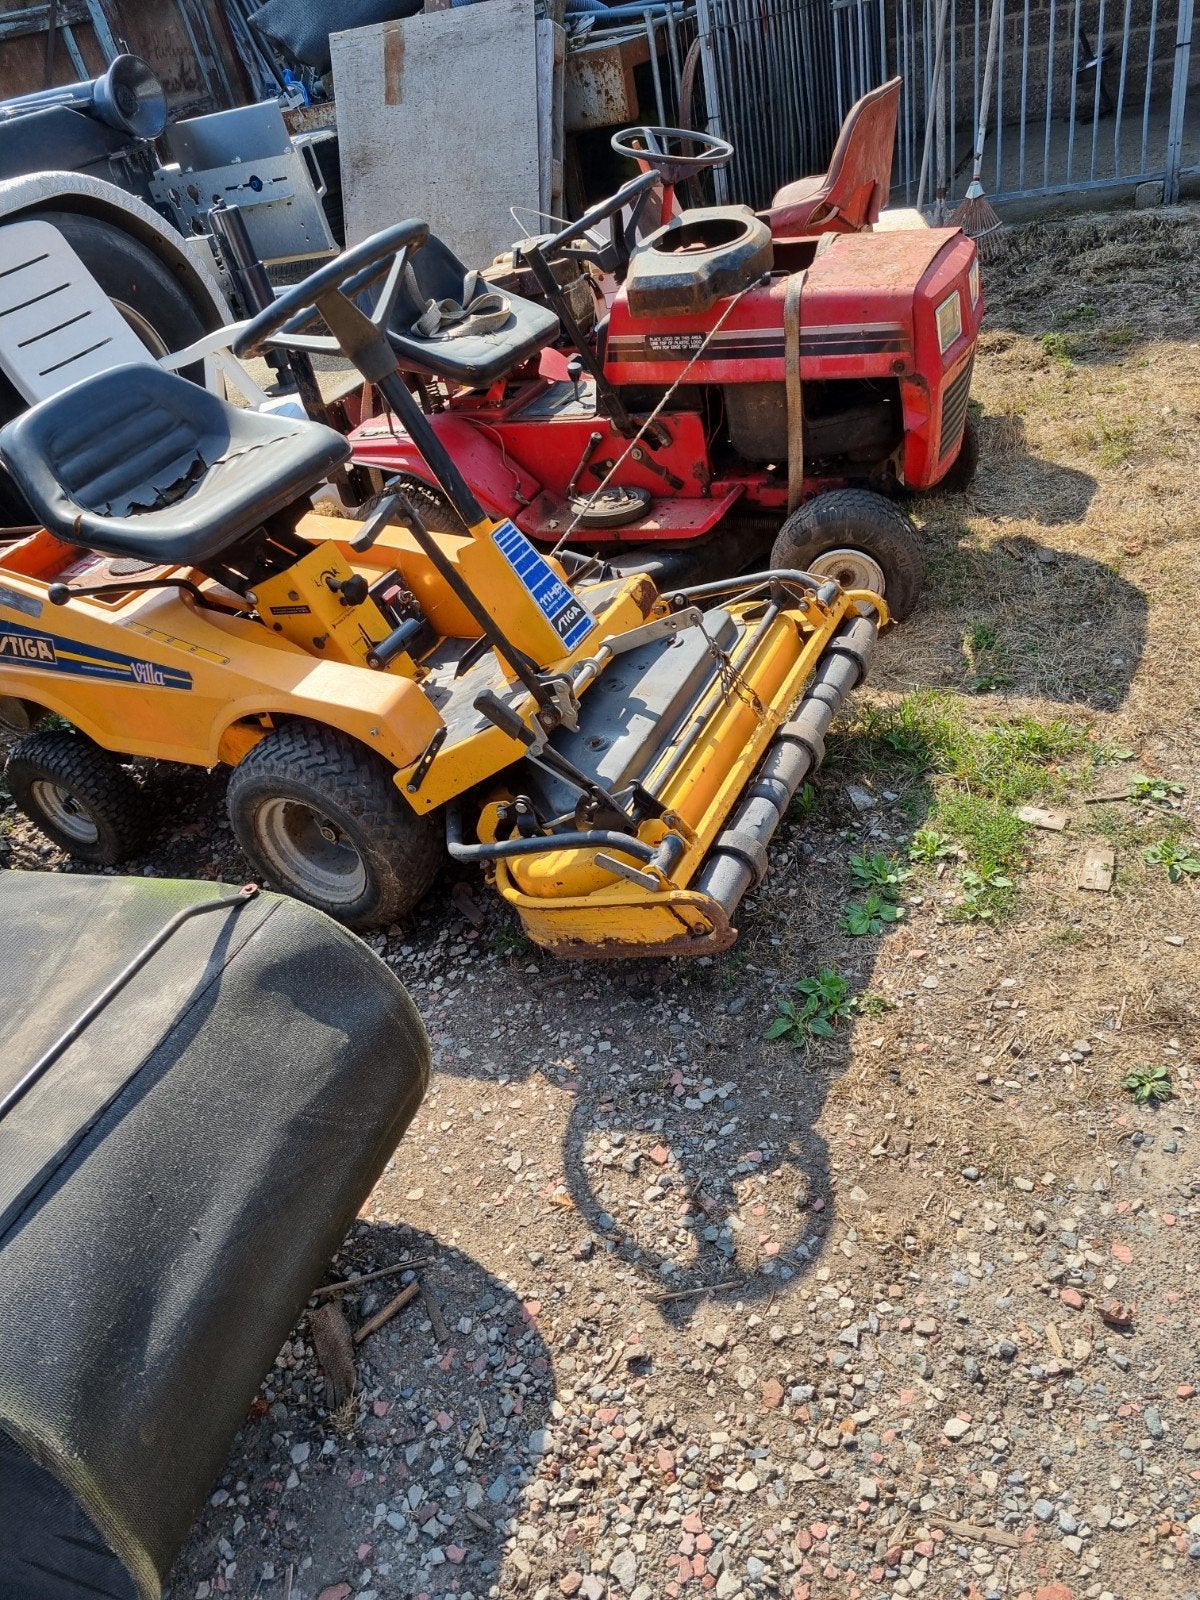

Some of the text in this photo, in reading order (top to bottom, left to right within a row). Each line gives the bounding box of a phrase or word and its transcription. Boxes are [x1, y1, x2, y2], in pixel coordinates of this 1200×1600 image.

[557, 605, 582, 632] STIGA
[0, 636, 53, 661] STIGA
[130, 661, 166, 686] Villa
